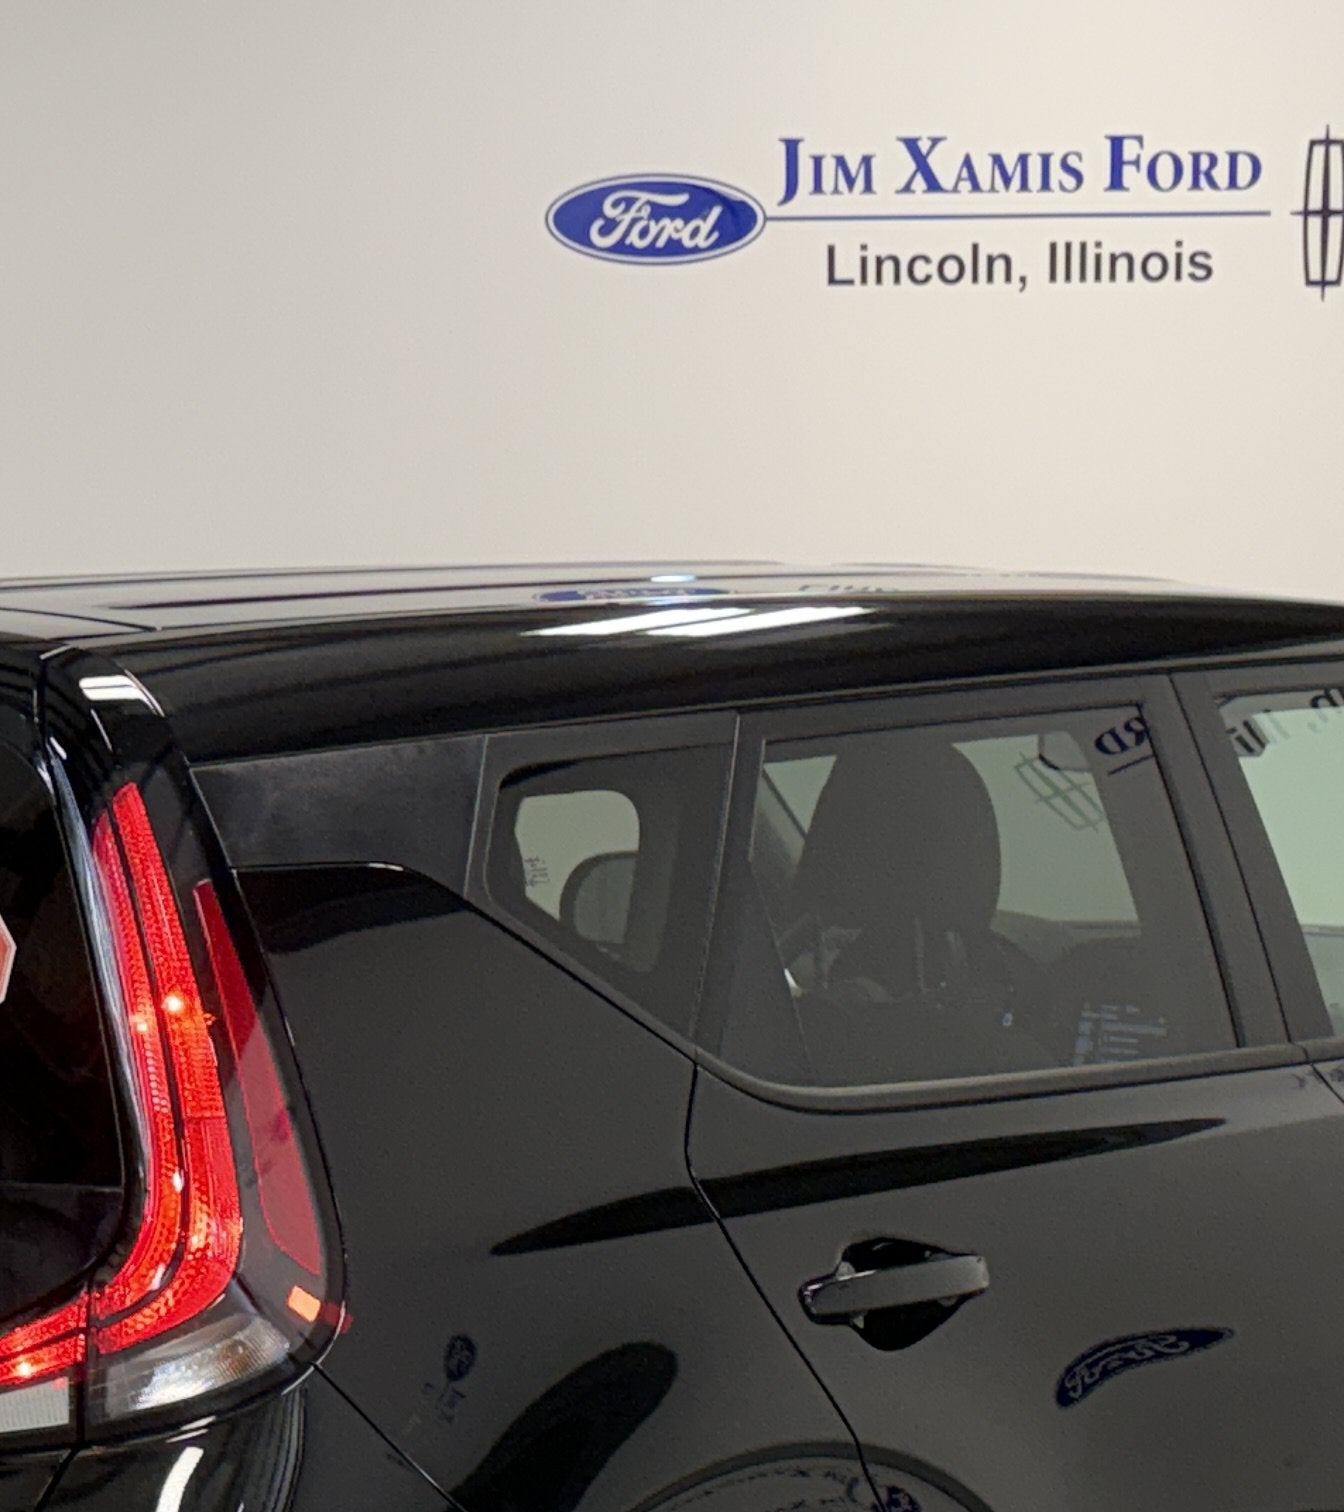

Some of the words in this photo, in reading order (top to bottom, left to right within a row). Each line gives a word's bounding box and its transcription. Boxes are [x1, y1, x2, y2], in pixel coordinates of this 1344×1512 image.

[777, 138, 876, 207] JIM
[895, 136, 1084, 195] XAMIS
[1104, 135, 1263, 193] FORD
[589, 190, 719, 250] Ford
[827, 243, 1028, 292] Lincoln,
[1047, 242, 1214, 284] Illinois
